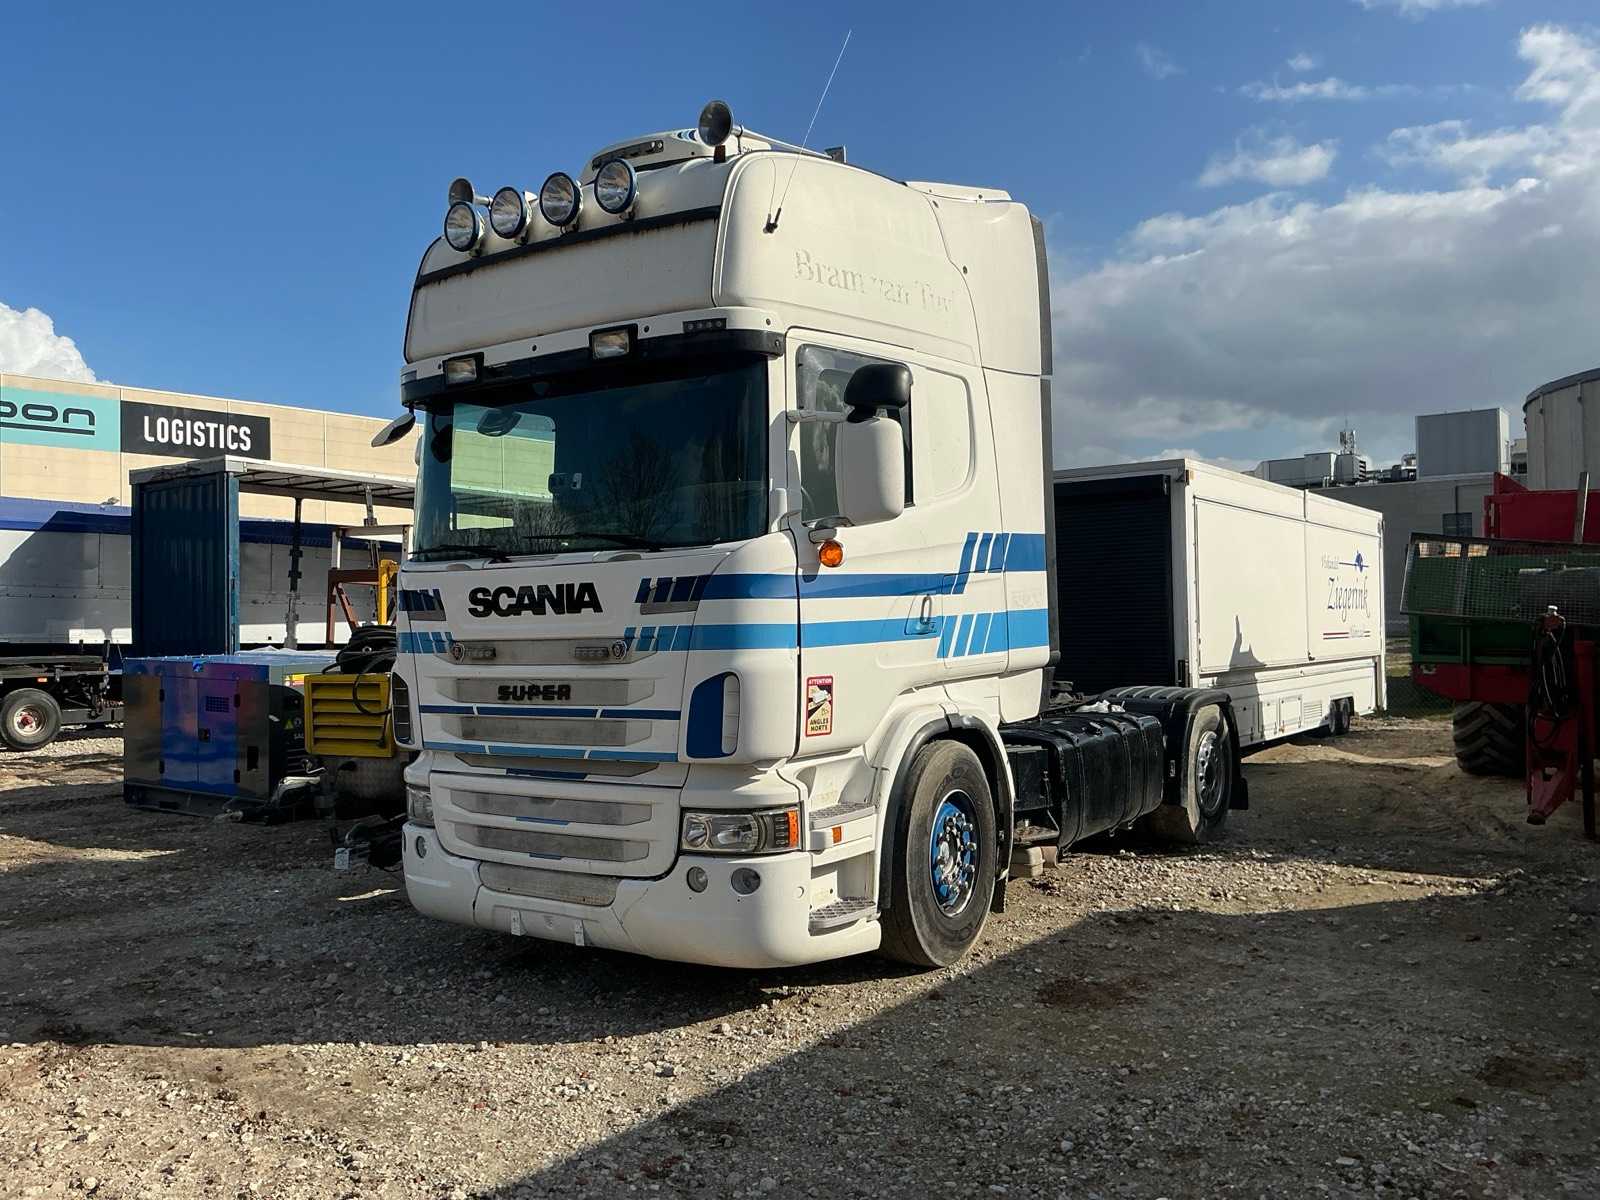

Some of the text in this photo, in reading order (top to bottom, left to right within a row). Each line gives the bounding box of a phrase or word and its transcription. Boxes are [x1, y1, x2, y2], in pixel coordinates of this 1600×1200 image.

[794, 249, 863, 293] Bram
[143, 415, 251, 451] LOGISTICS
[468, 582, 603, 618] SCANIA
[497, 684, 571, 701] SUPER
